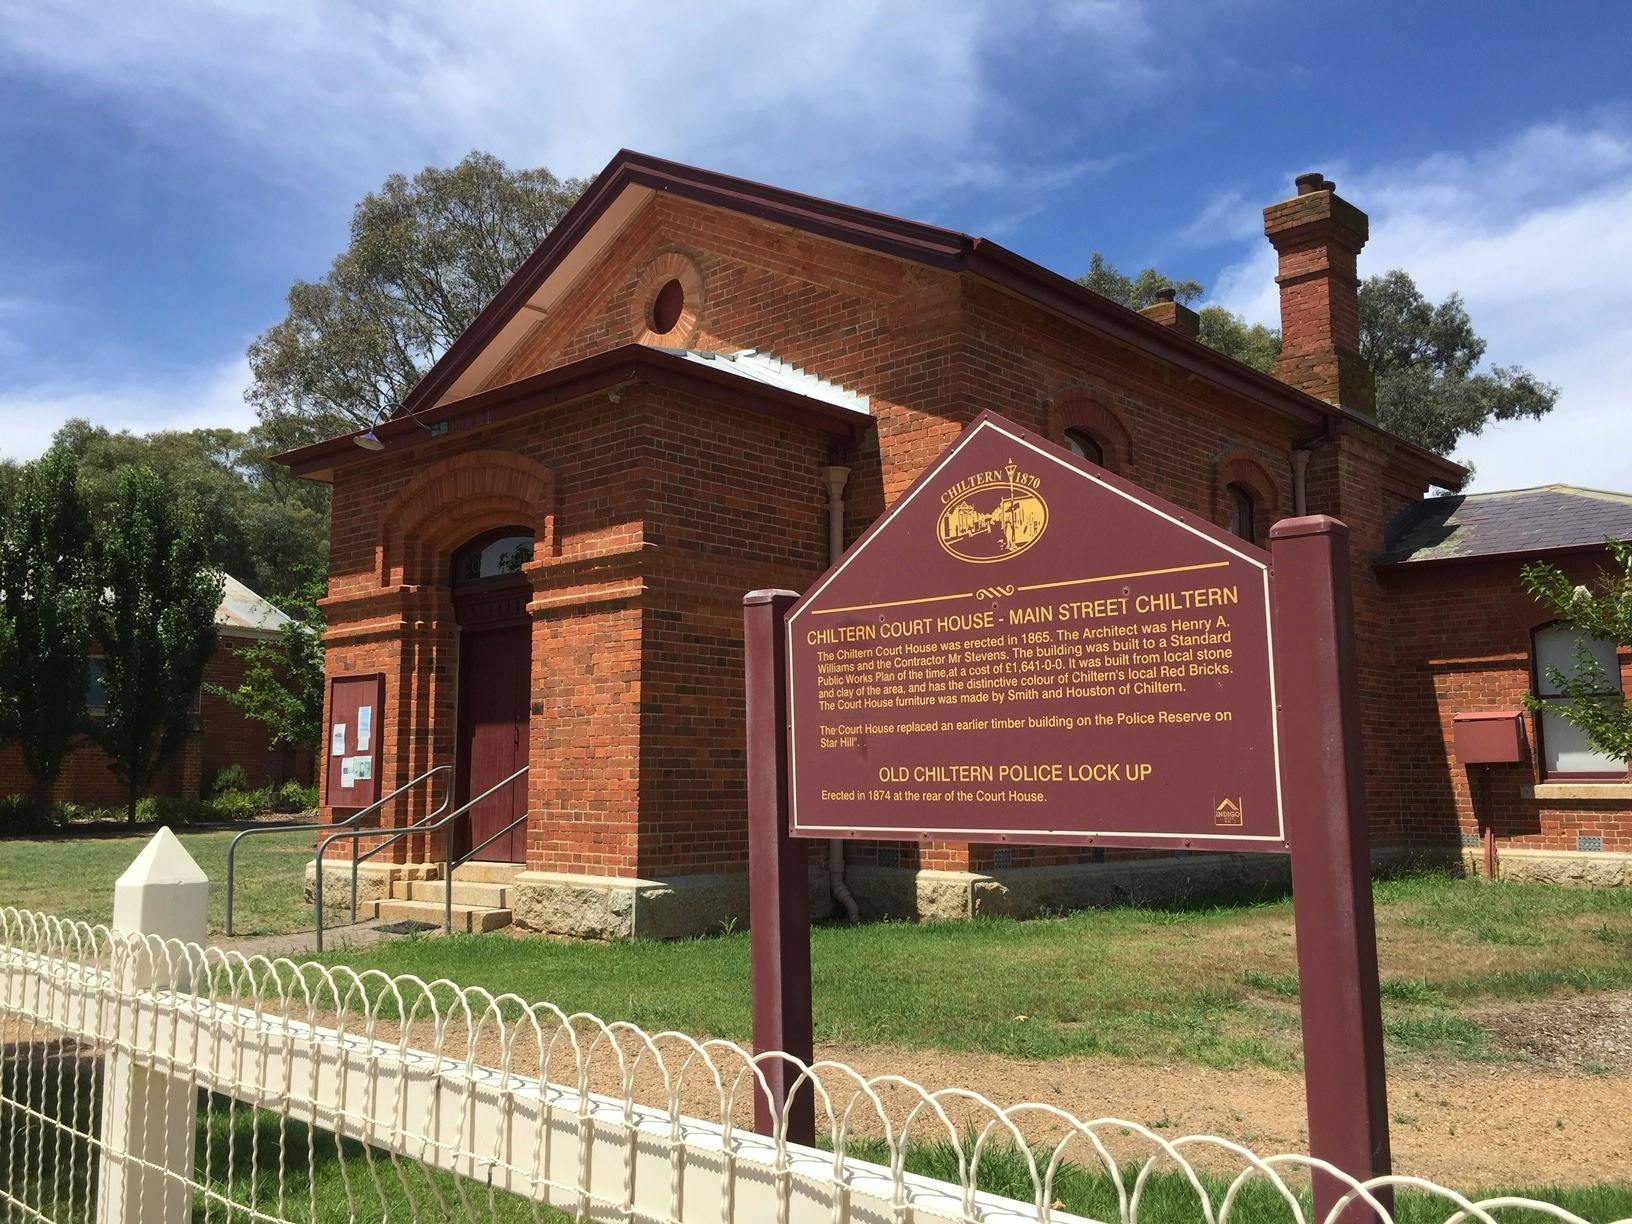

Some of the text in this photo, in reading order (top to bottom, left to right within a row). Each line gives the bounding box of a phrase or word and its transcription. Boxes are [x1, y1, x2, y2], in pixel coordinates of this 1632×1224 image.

[940, 470, 1041, 504] CHILTERN 1870
[807, 625, 875, 645] CHILTERN
[880, 619, 932, 638] COURT
[938, 612, 994, 632] HOUSE
[1010, 606, 1052, 624] MAIN
[1059, 598, 1127, 620] STREET
[1136, 586, 1237, 613] CHILTERN
[817, 616, 1229, 661] The Chiltern Court House was erected in 1865. The Architect was Henry A.
[818, 631, 1231, 673] Williams and the Contractor Mr Stevens. The building was built to a Standard
[818, 675, 844, 686] Public
[846, 673, 873, 683] Works
[876, 672, 894, 681] Plan
[897, 670, 906, 680] of
[909, 670, 923, 679] the
[961, 668, 966, 676] a
[969, 665, 990, 675] cost
[993, 663, 1003, 674] of
[1005, 659, 1065, 674] £1,641-0-0.
[1069, 658, 1075, 668] It
[1079, 658, 1101, 667] was
[1105, 654, 1129, 666] built
[1133, 653, 1160, 664] from
[1164, 649, 1193, 662] local
[1197, 649, 1232, 660] stone
[819, 663, 1232, 698] and clay of the area, and has the distinctive colour of Chiltern's local Red Bricks.
[819, 682, 1186, 710] The Court House furniture was made by Smith and Houston of Chiltern.
[820, 712, 1231, 735] The Court House replaced an earlier timber building on the Police Reserve on
[821, 738, 837, 748] Star
[879, 764, 1151, 782] OLD CHILTERN POLICE LOCK UP
[822, 790, 1047, 801] Erected in 1874 at the rear of the Court House.
